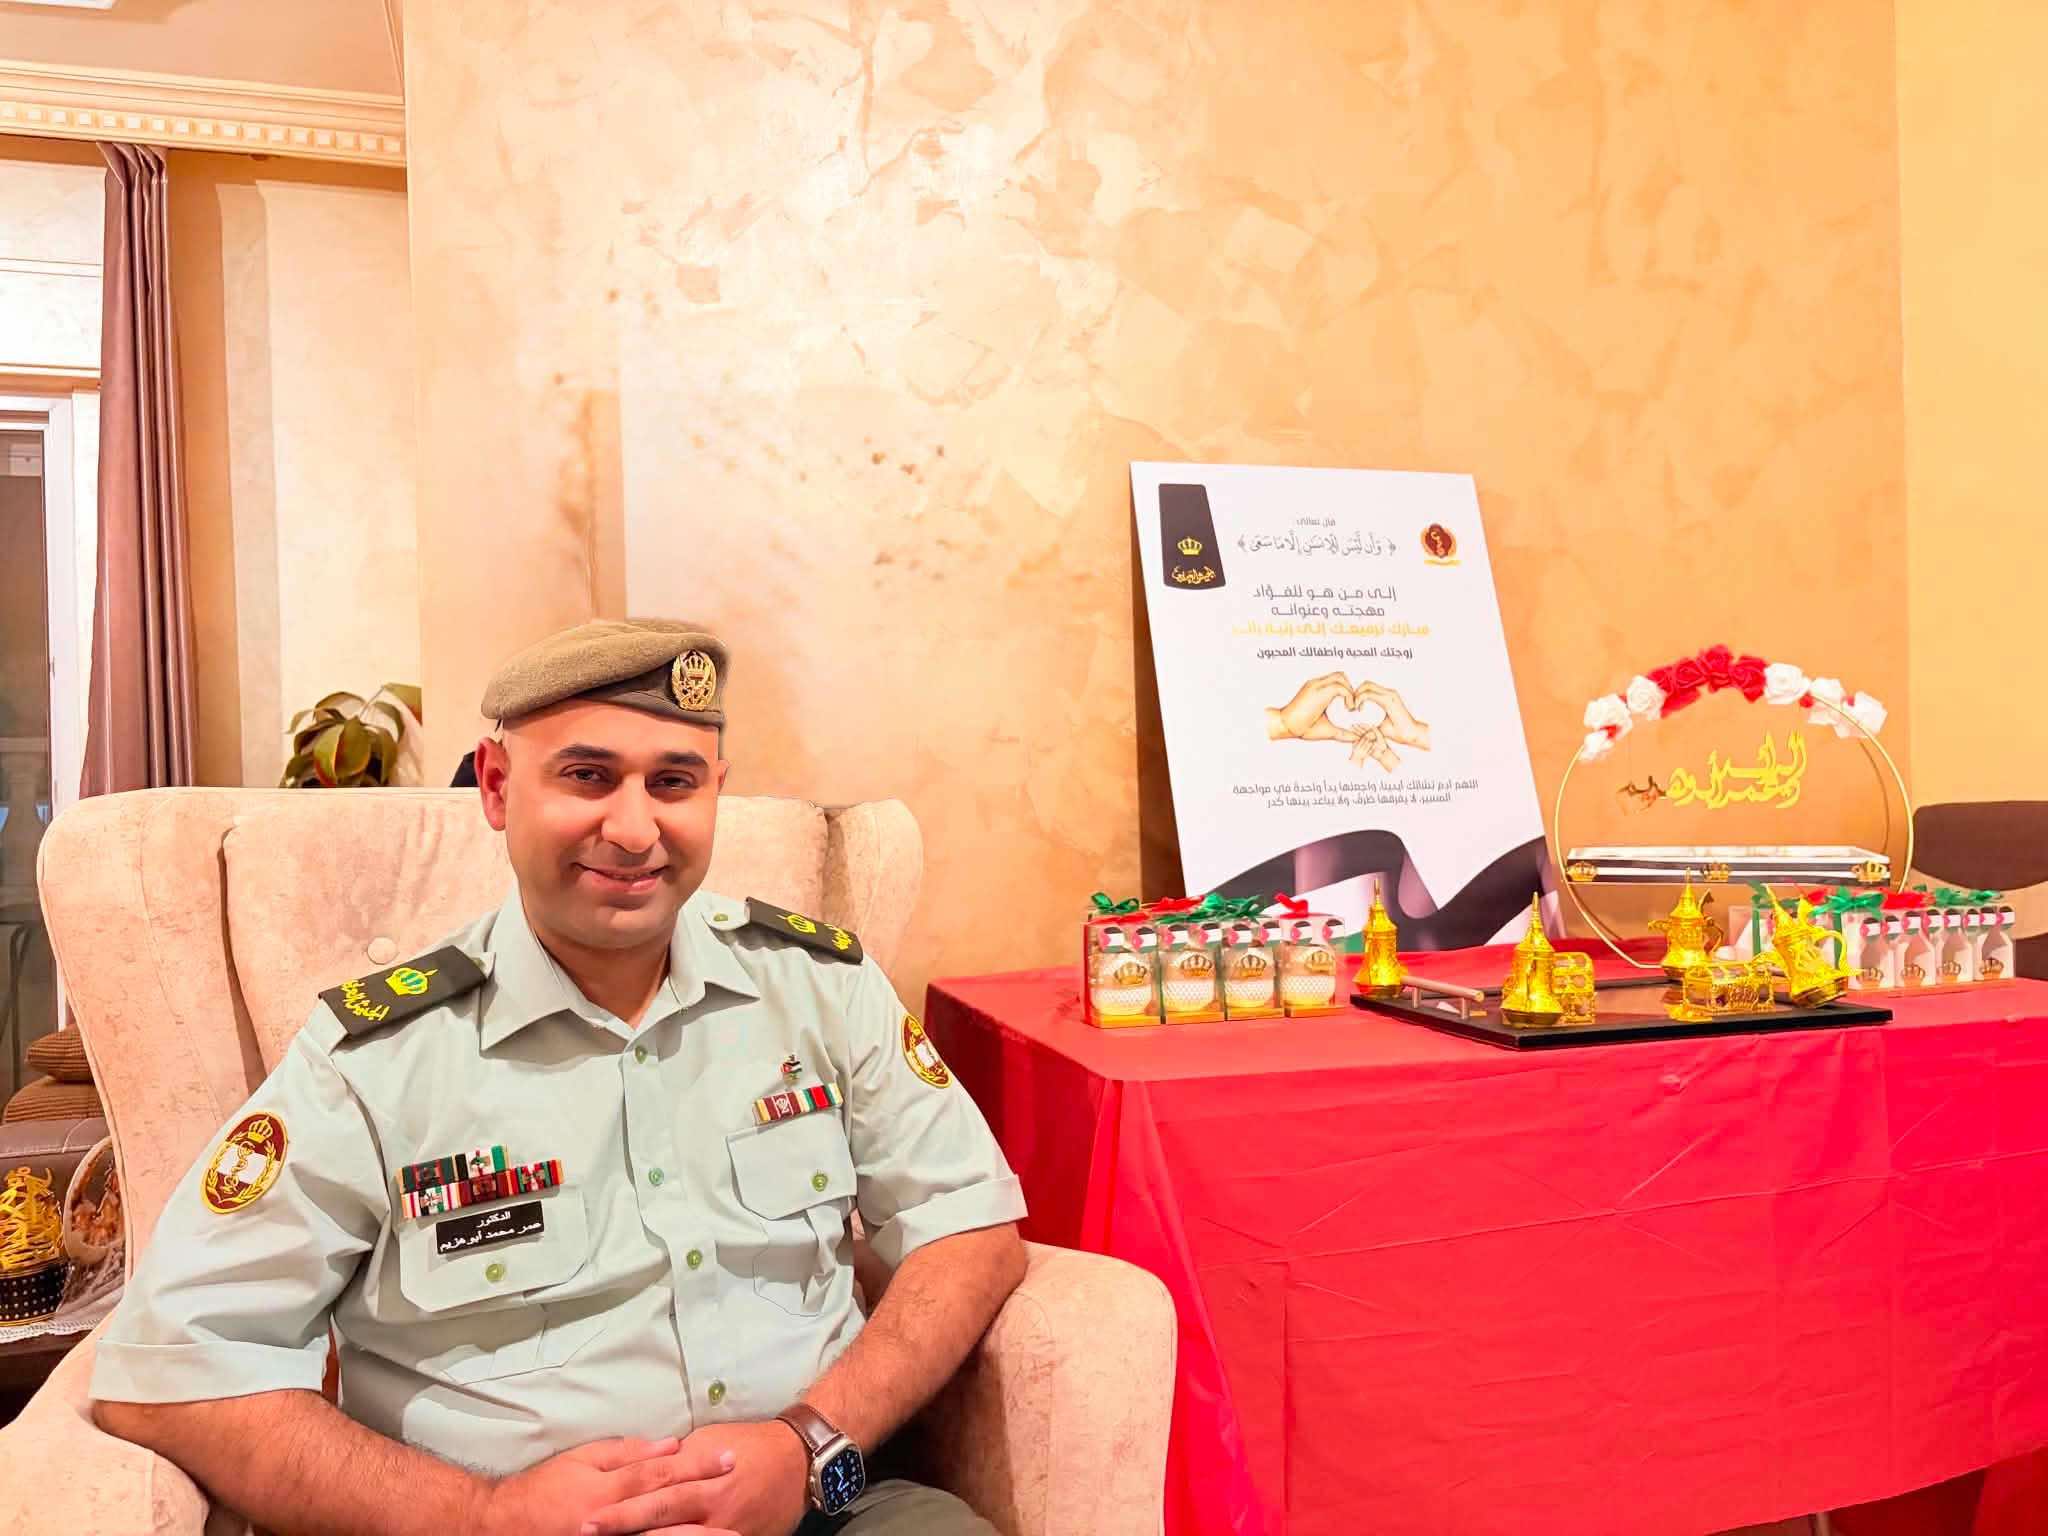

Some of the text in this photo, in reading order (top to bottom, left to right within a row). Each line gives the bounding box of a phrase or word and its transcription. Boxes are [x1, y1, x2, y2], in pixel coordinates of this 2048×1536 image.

[1253, 583, 1397, 601] إلى من هو للفؤاد
[1271, 603, 1385, 619] مهجته وعنوانه
[1256, 646, 1296, 659] المحبون
[1345, 647, 1378, 658] المحبة
[1380, 647, 1414, 660] زوجتك
[1232, 783, 1271, 796] مواجهة
[1273, 782, 1291, 795] في
[1455, 778, 1479, 791] اللهم
[476, 1210, 511, 1228] الدكتور
[485, 1228, 515, 1239] محمد
[517, 1222, 542, 1234] عمر
